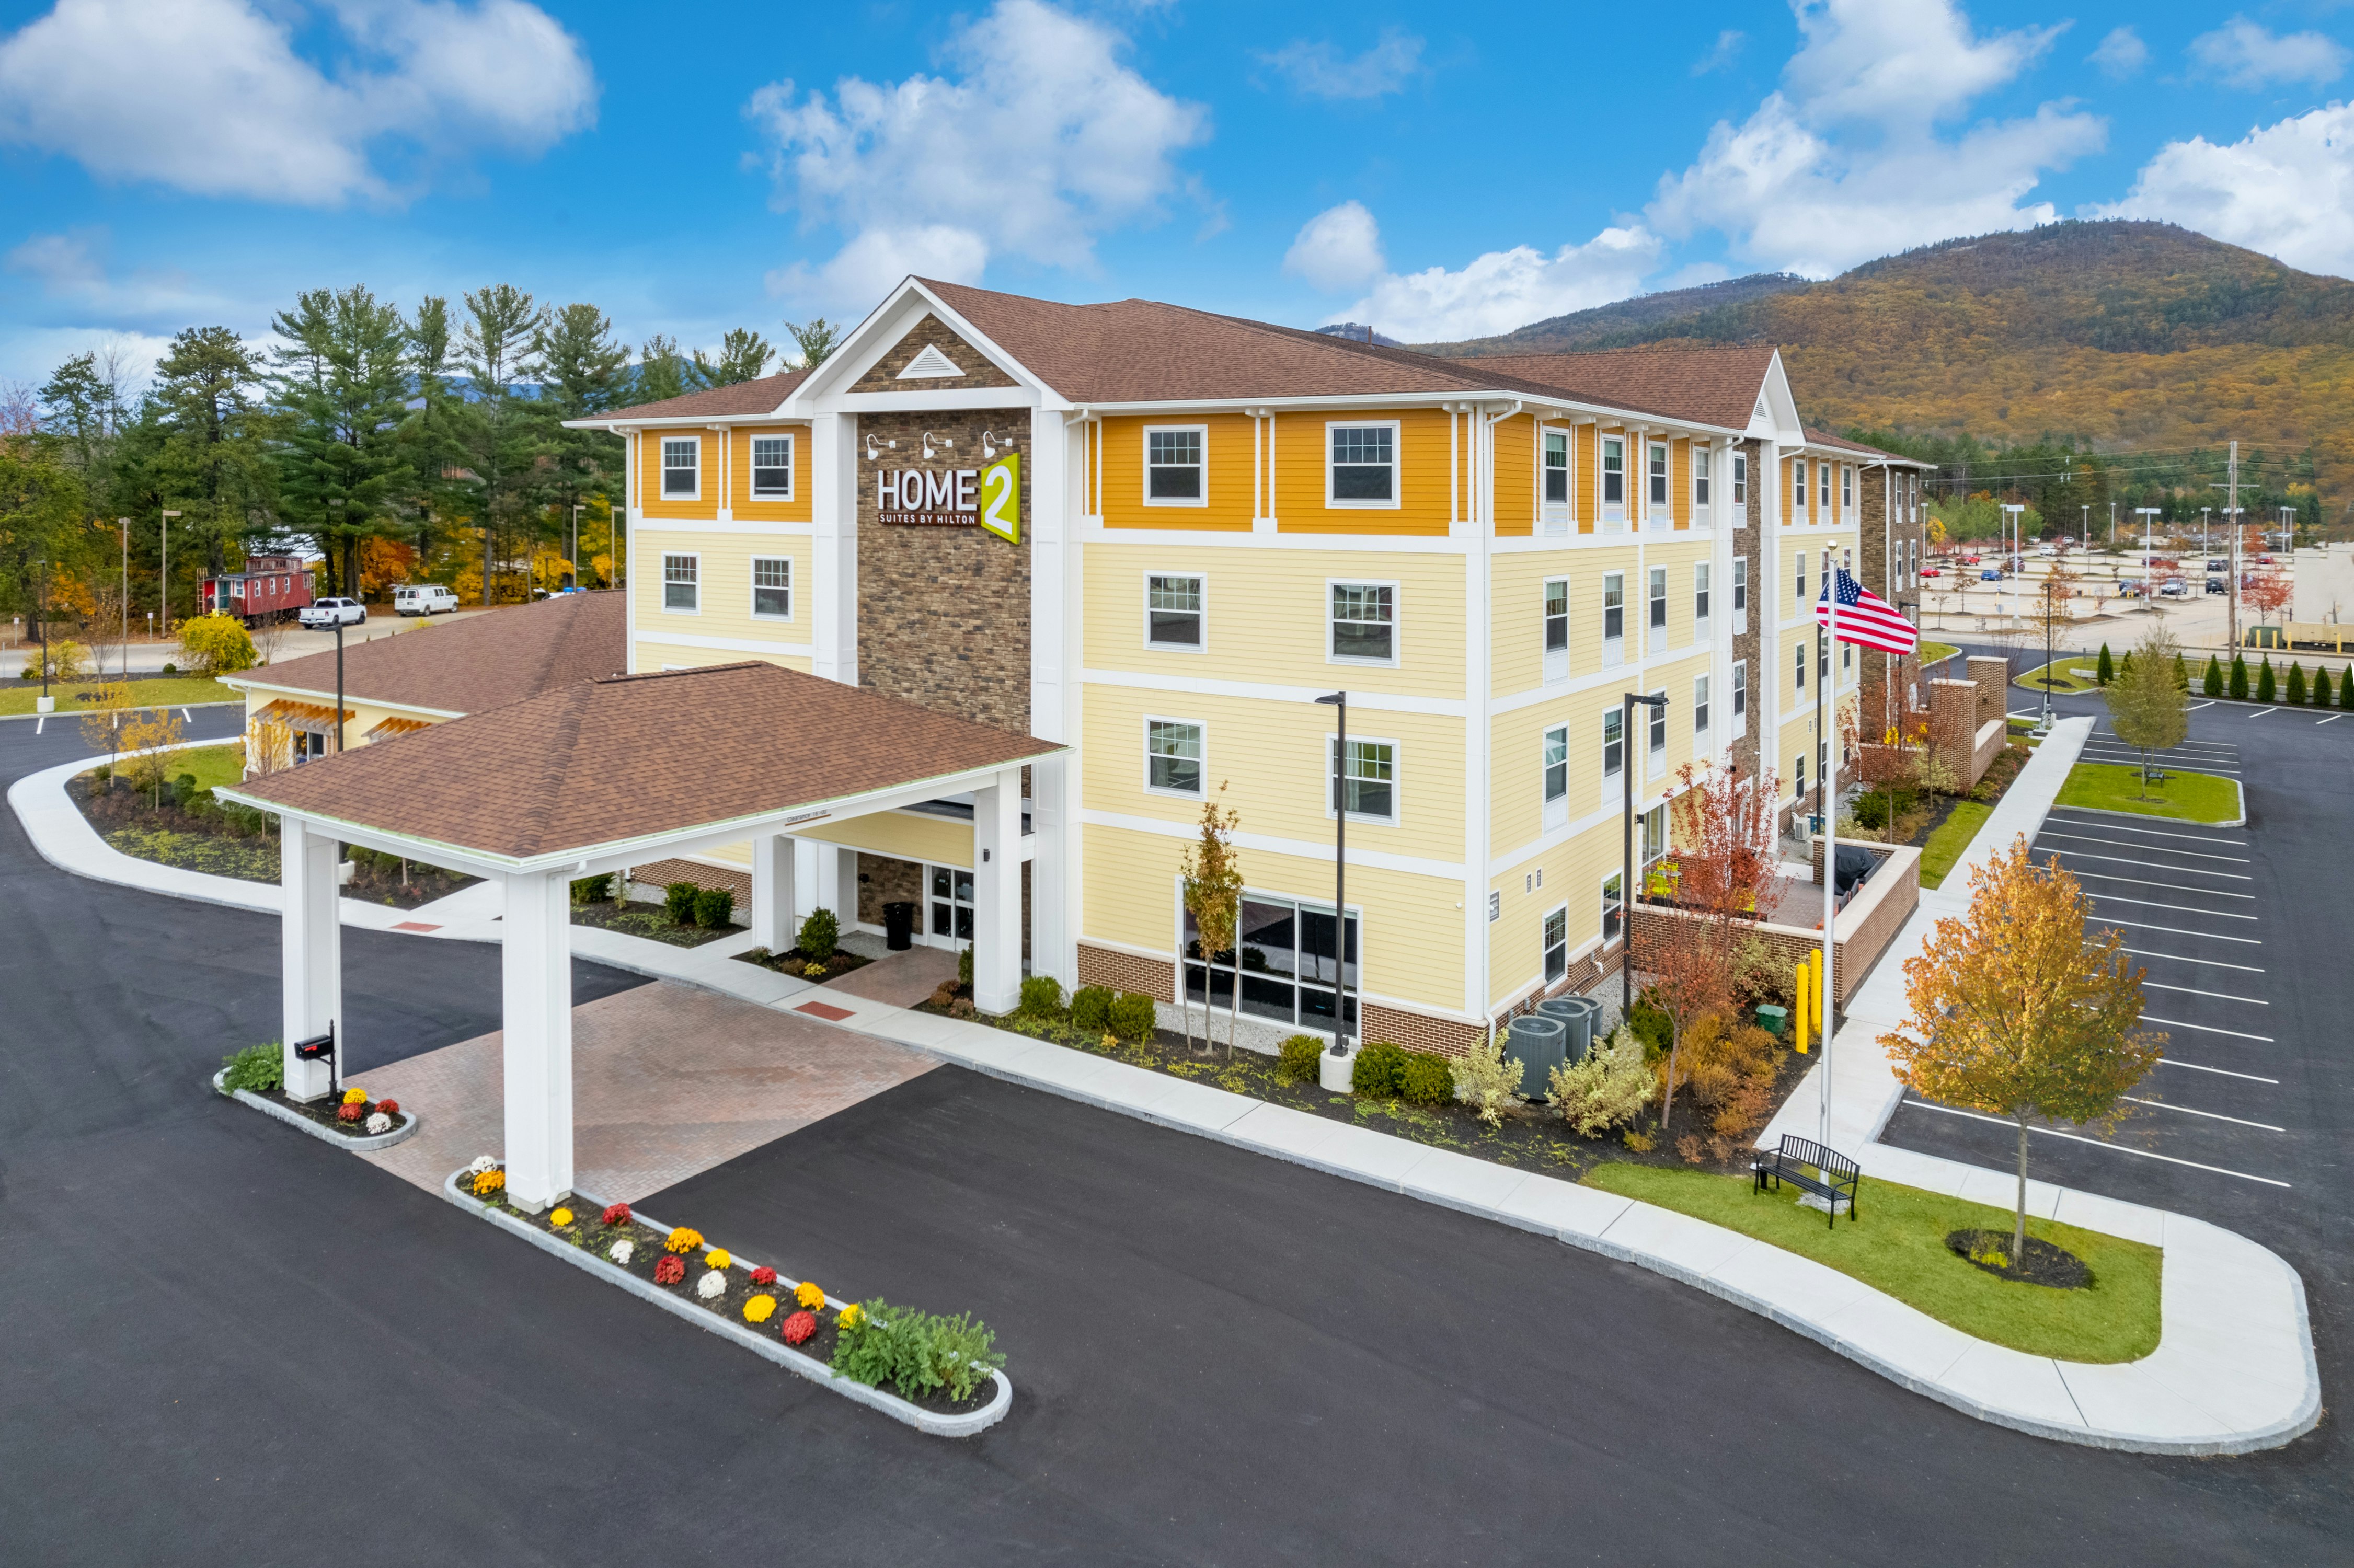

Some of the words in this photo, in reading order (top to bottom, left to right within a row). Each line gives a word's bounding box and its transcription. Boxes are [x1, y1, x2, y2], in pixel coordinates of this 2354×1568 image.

[878, 470, 977, 511] HOME
[985, 465, 1013, 535] 2
[880, 514, 915, 523] SUITES
[920, 514, 933, 523] BY
[937, 515, 975, 524] HILTON
[787, 813, 810, 823] Clearance
